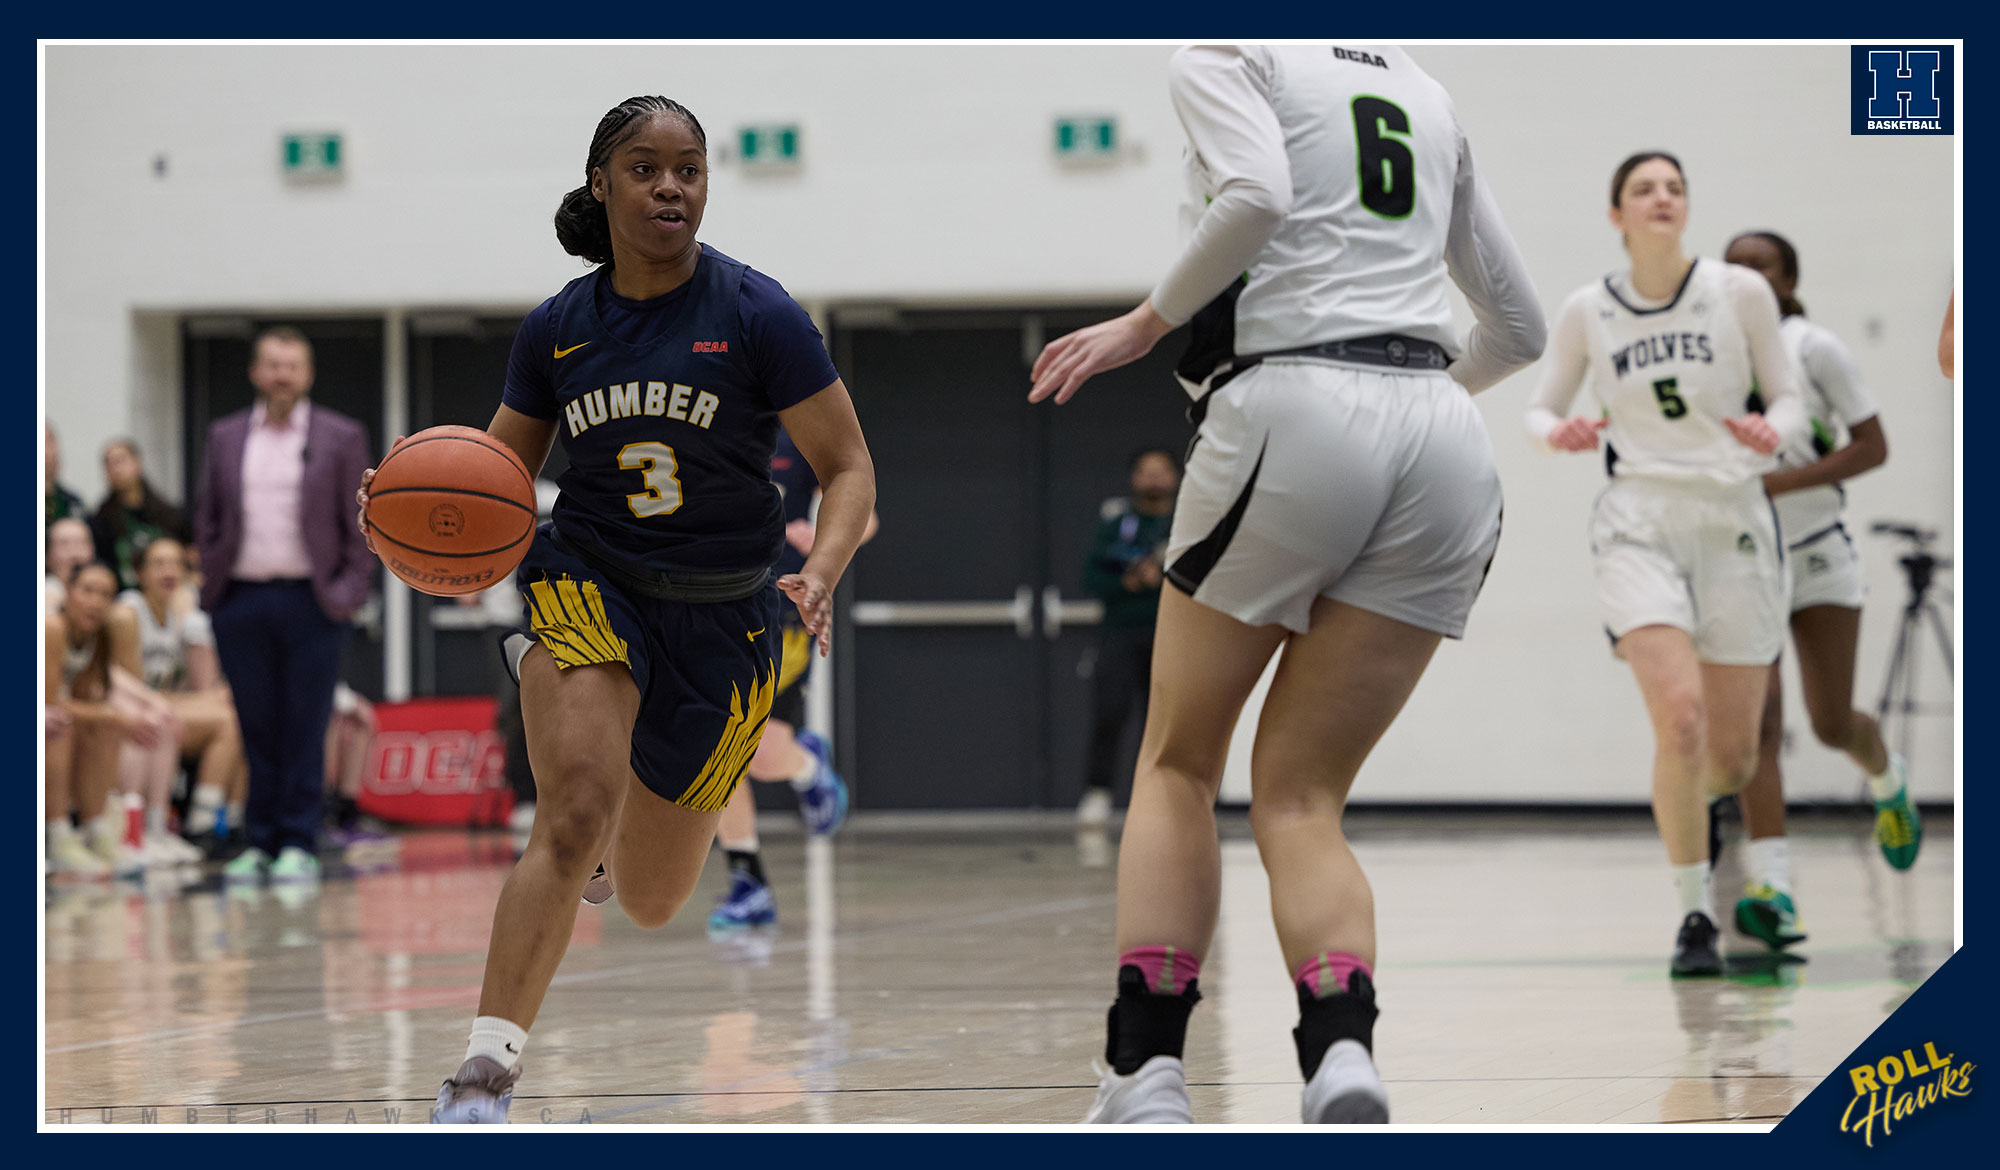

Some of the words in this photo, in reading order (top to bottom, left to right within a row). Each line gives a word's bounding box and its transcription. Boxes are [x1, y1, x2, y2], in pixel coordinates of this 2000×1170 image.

[1332, 46, 1389, 69] OCAA
[1349, 93, 1416, 221] 6
[692, 341, 728, 353] OCAA
[1611, 332, 1713, 378] WOLVES
[564, 381, 720, 438] HUMBER
[1652, 378, 1687, 420] 5
[616, 441, 684, 519] 3
